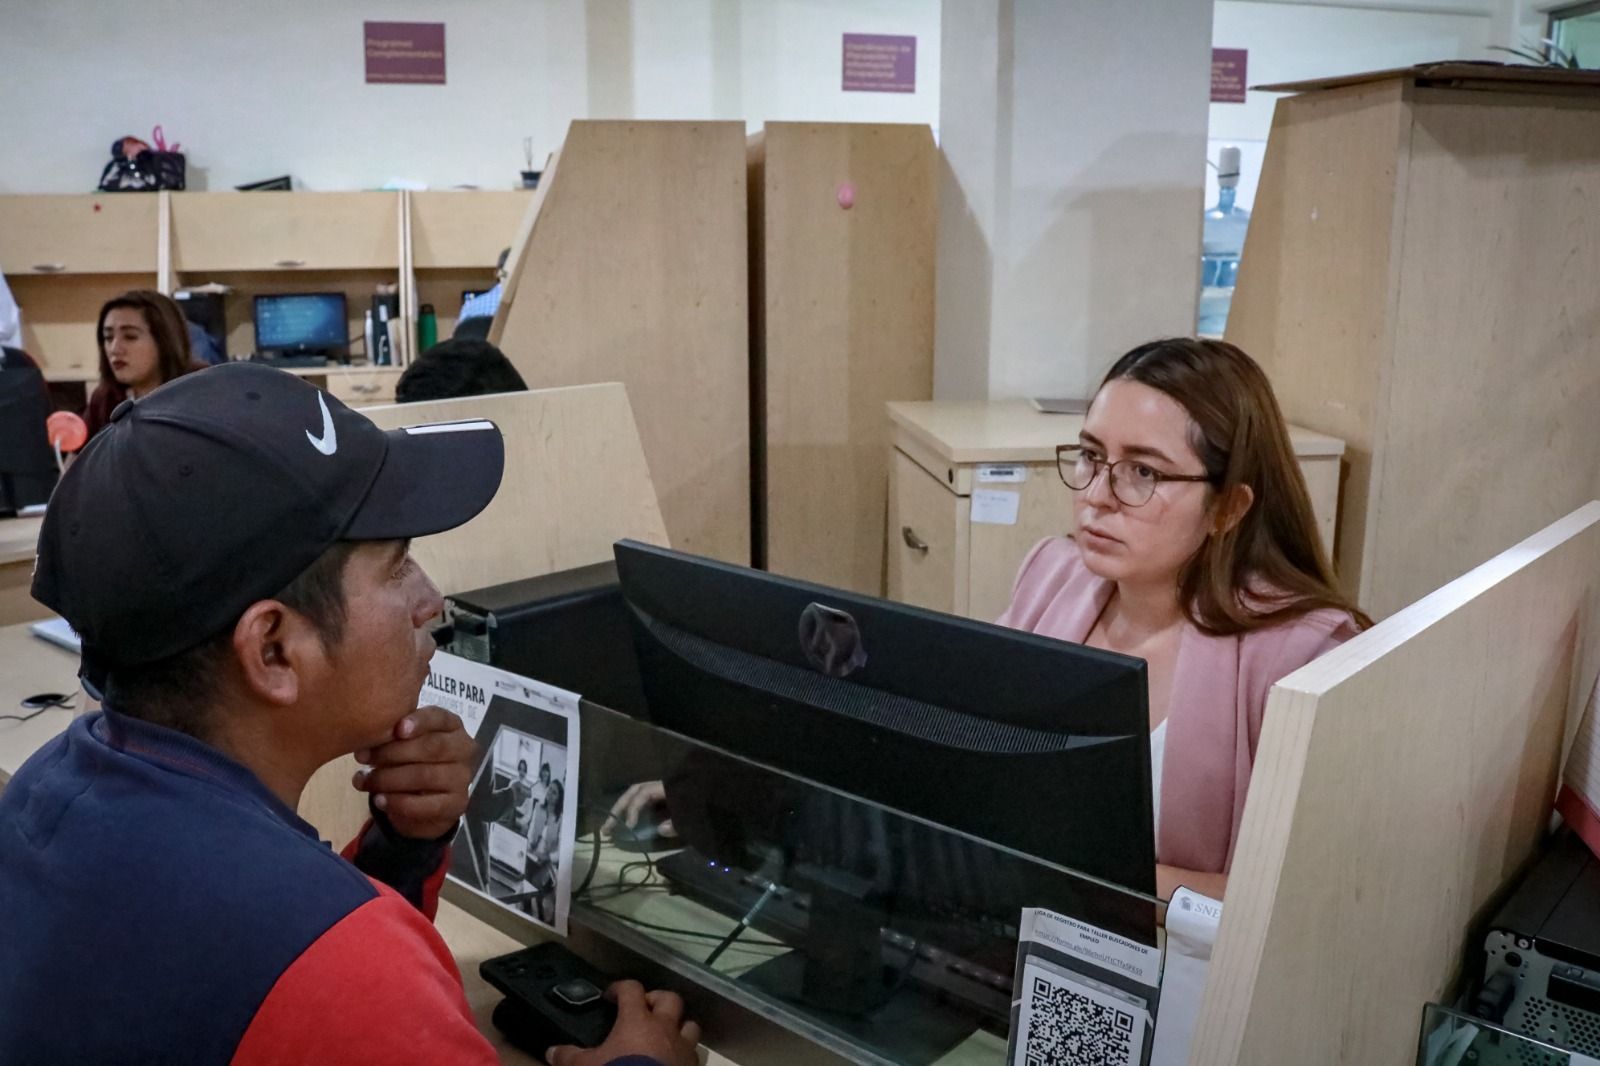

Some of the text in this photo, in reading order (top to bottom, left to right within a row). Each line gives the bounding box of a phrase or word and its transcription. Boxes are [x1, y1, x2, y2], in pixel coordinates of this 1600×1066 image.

[423, 671, 486, 706] ALLER PARA
[1091, 928, 1108, 940] TALLER
